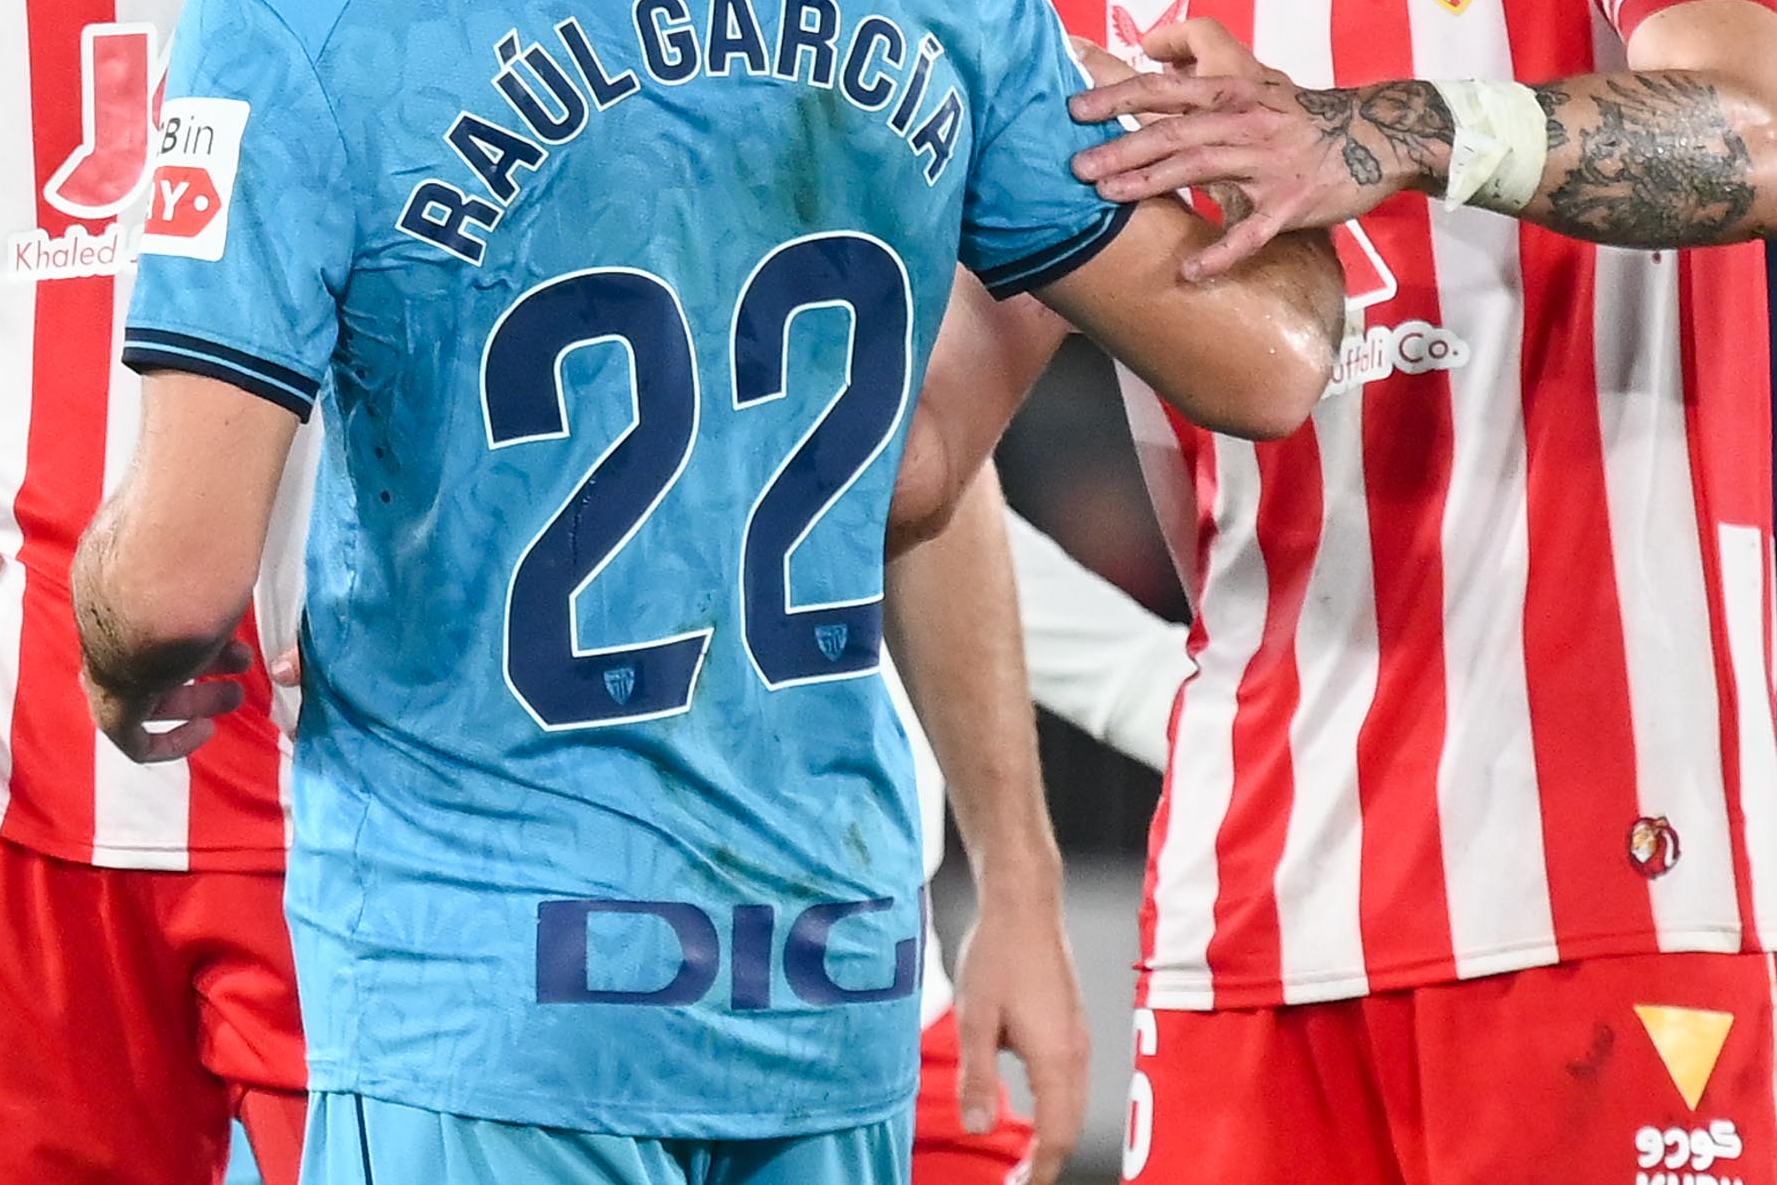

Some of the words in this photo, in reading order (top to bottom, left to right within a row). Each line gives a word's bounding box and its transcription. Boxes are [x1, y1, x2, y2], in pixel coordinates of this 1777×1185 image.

[155, 115, 215, 158] Bin
[394, 15, 641, 268] RAÚL
[15, 233, 118, 273] Khaled
[1398, 332, 1459, 363] Co.
[479, 230, 914, 732] 22
[536, 885, 927, 1012] DIG
